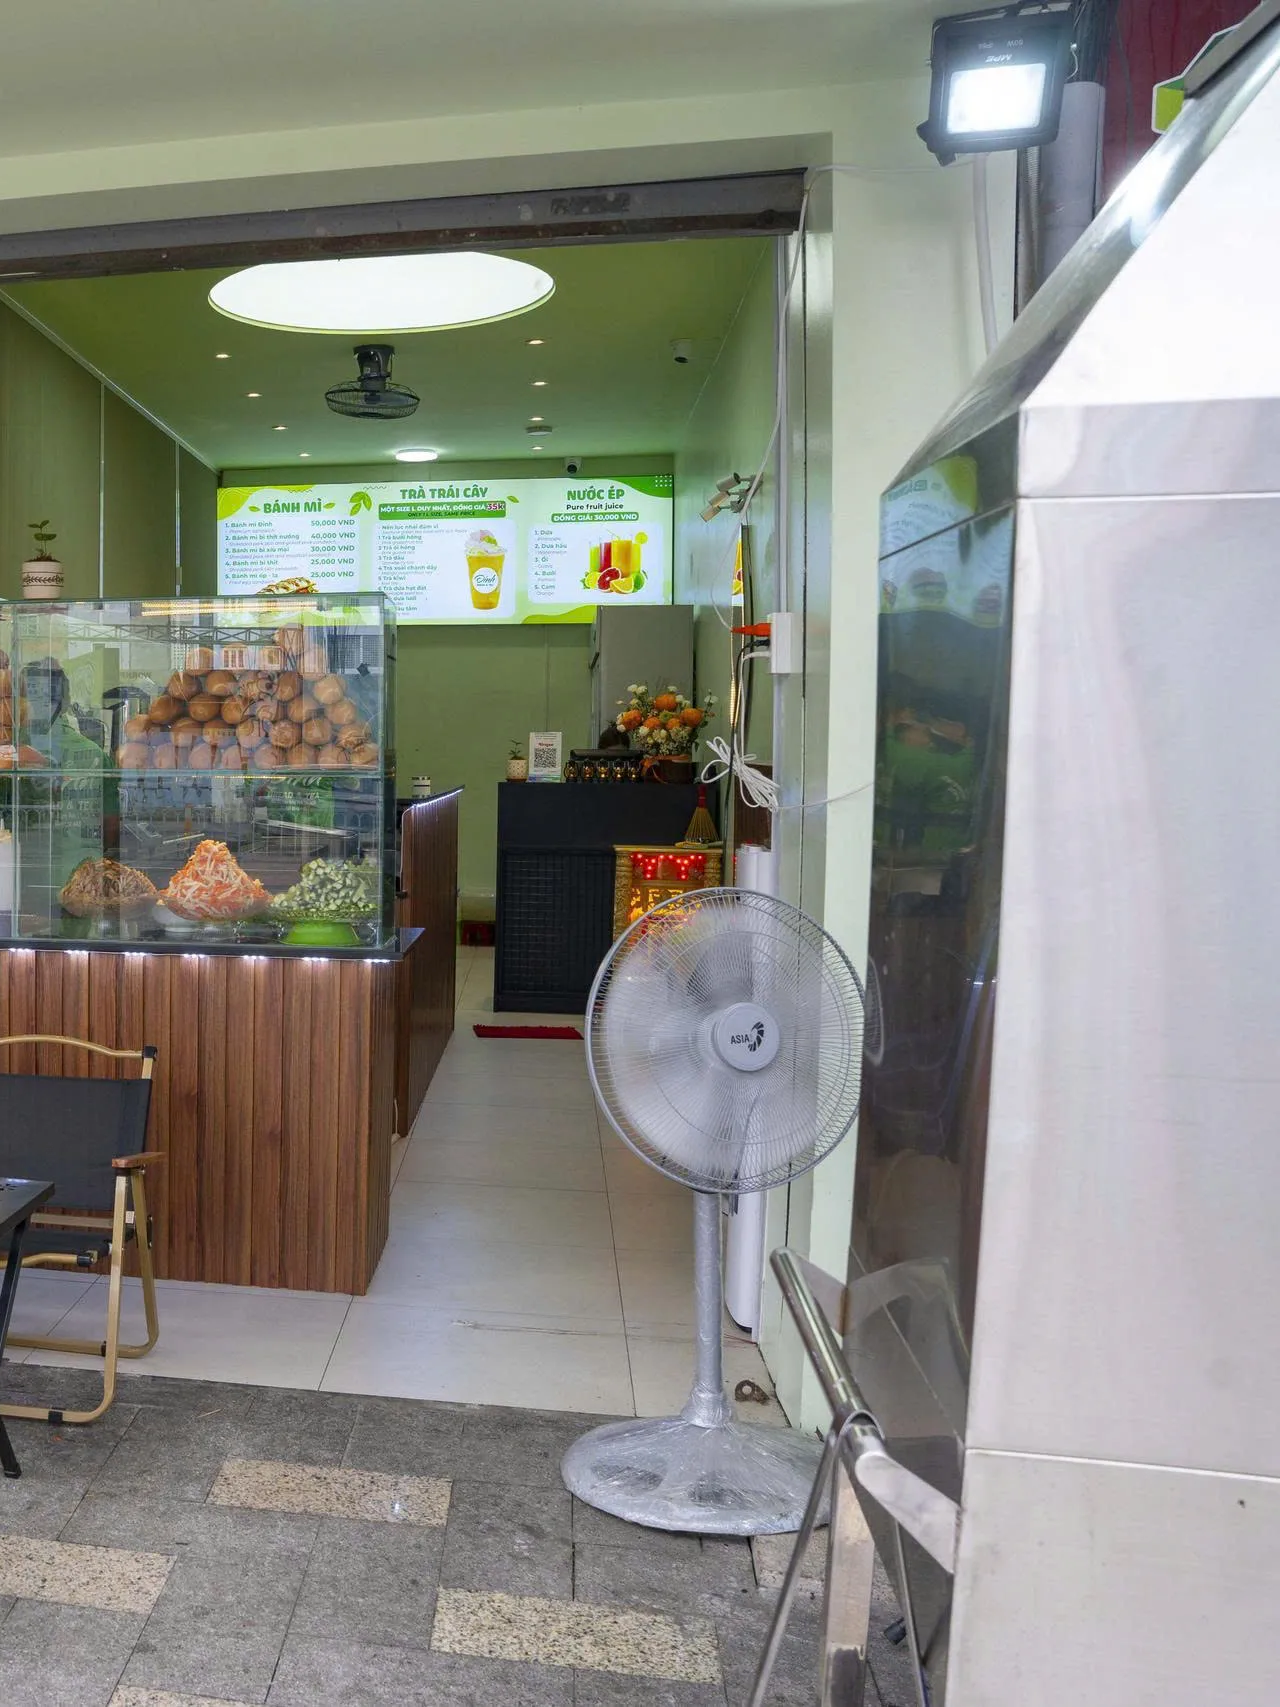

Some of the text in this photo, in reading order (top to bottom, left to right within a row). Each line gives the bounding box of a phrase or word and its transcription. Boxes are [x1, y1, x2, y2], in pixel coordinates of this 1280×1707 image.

[400, 484, 488, 500] TRÀ TRÁI CÂY
[567, 486, 625, 501] NƯỚC ÉP
[264, 498, 322, 514] BÁNH MÌ
[604, 503, 624, 511] juice
[731, 1034, 750, 1044] ASIA
